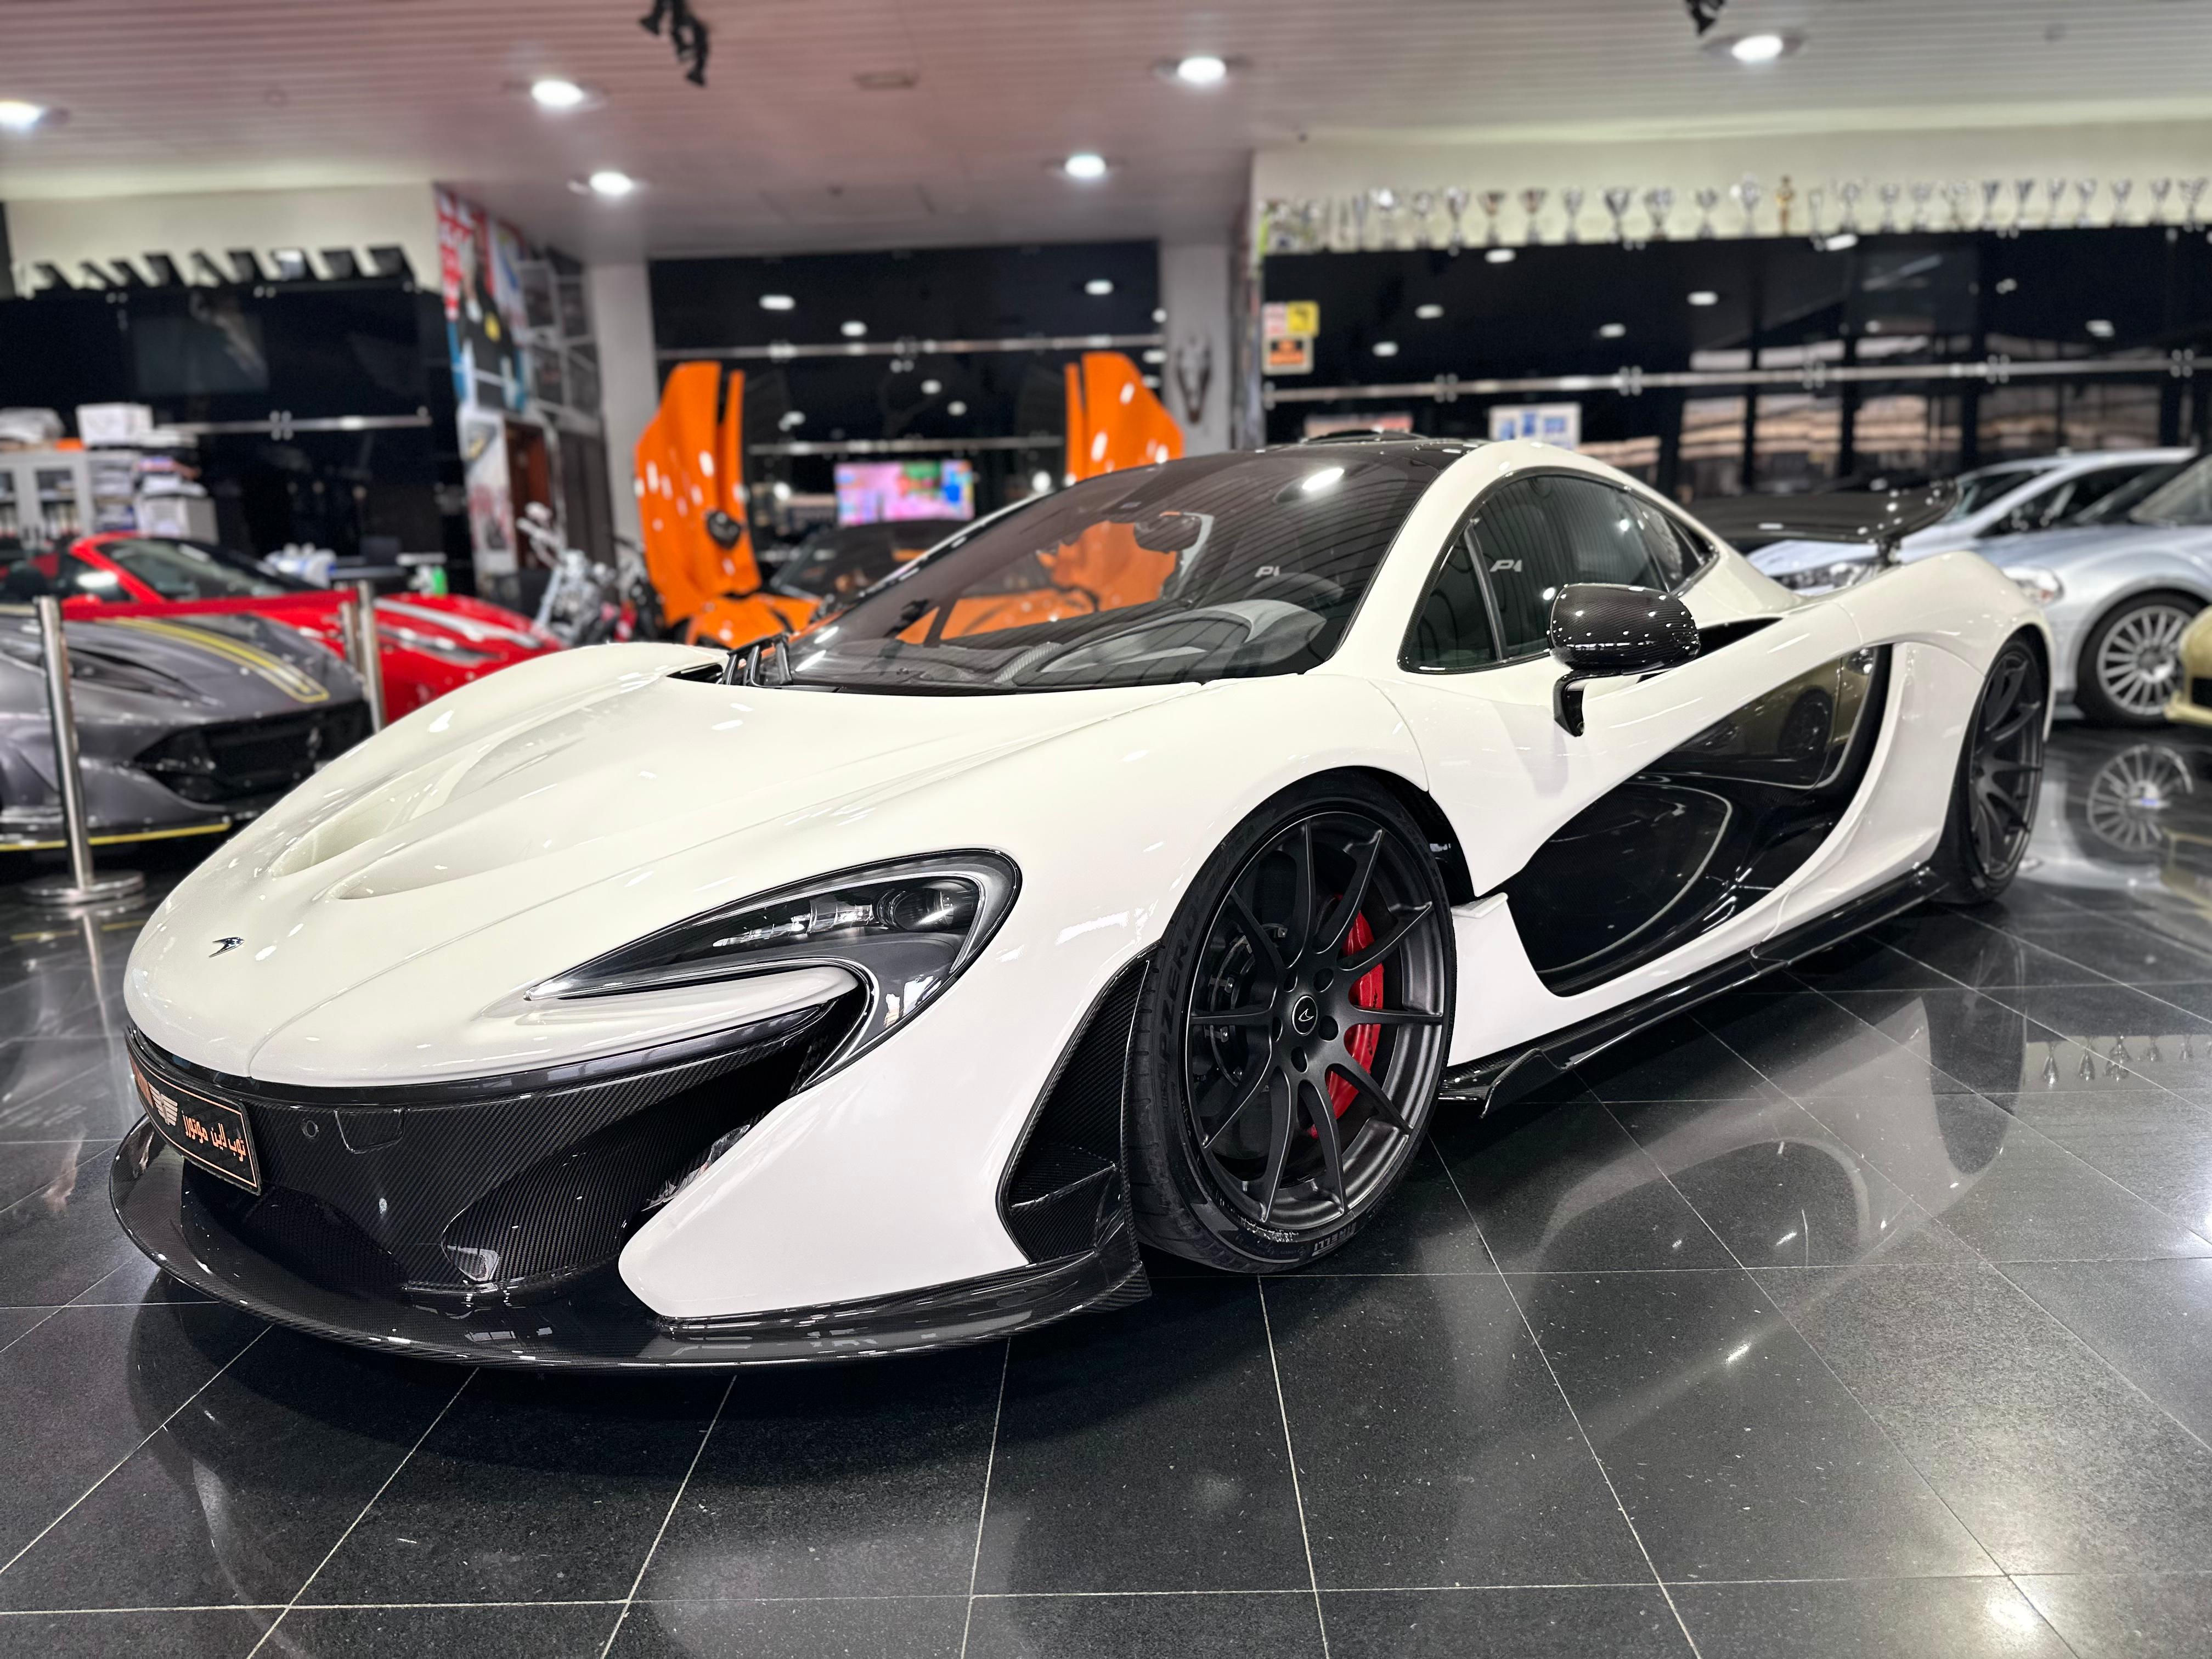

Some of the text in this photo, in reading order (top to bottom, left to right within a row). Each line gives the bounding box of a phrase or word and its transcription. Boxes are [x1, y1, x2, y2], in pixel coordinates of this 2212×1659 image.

[182, 1110, 246, 1162] توب لاين موتورز
